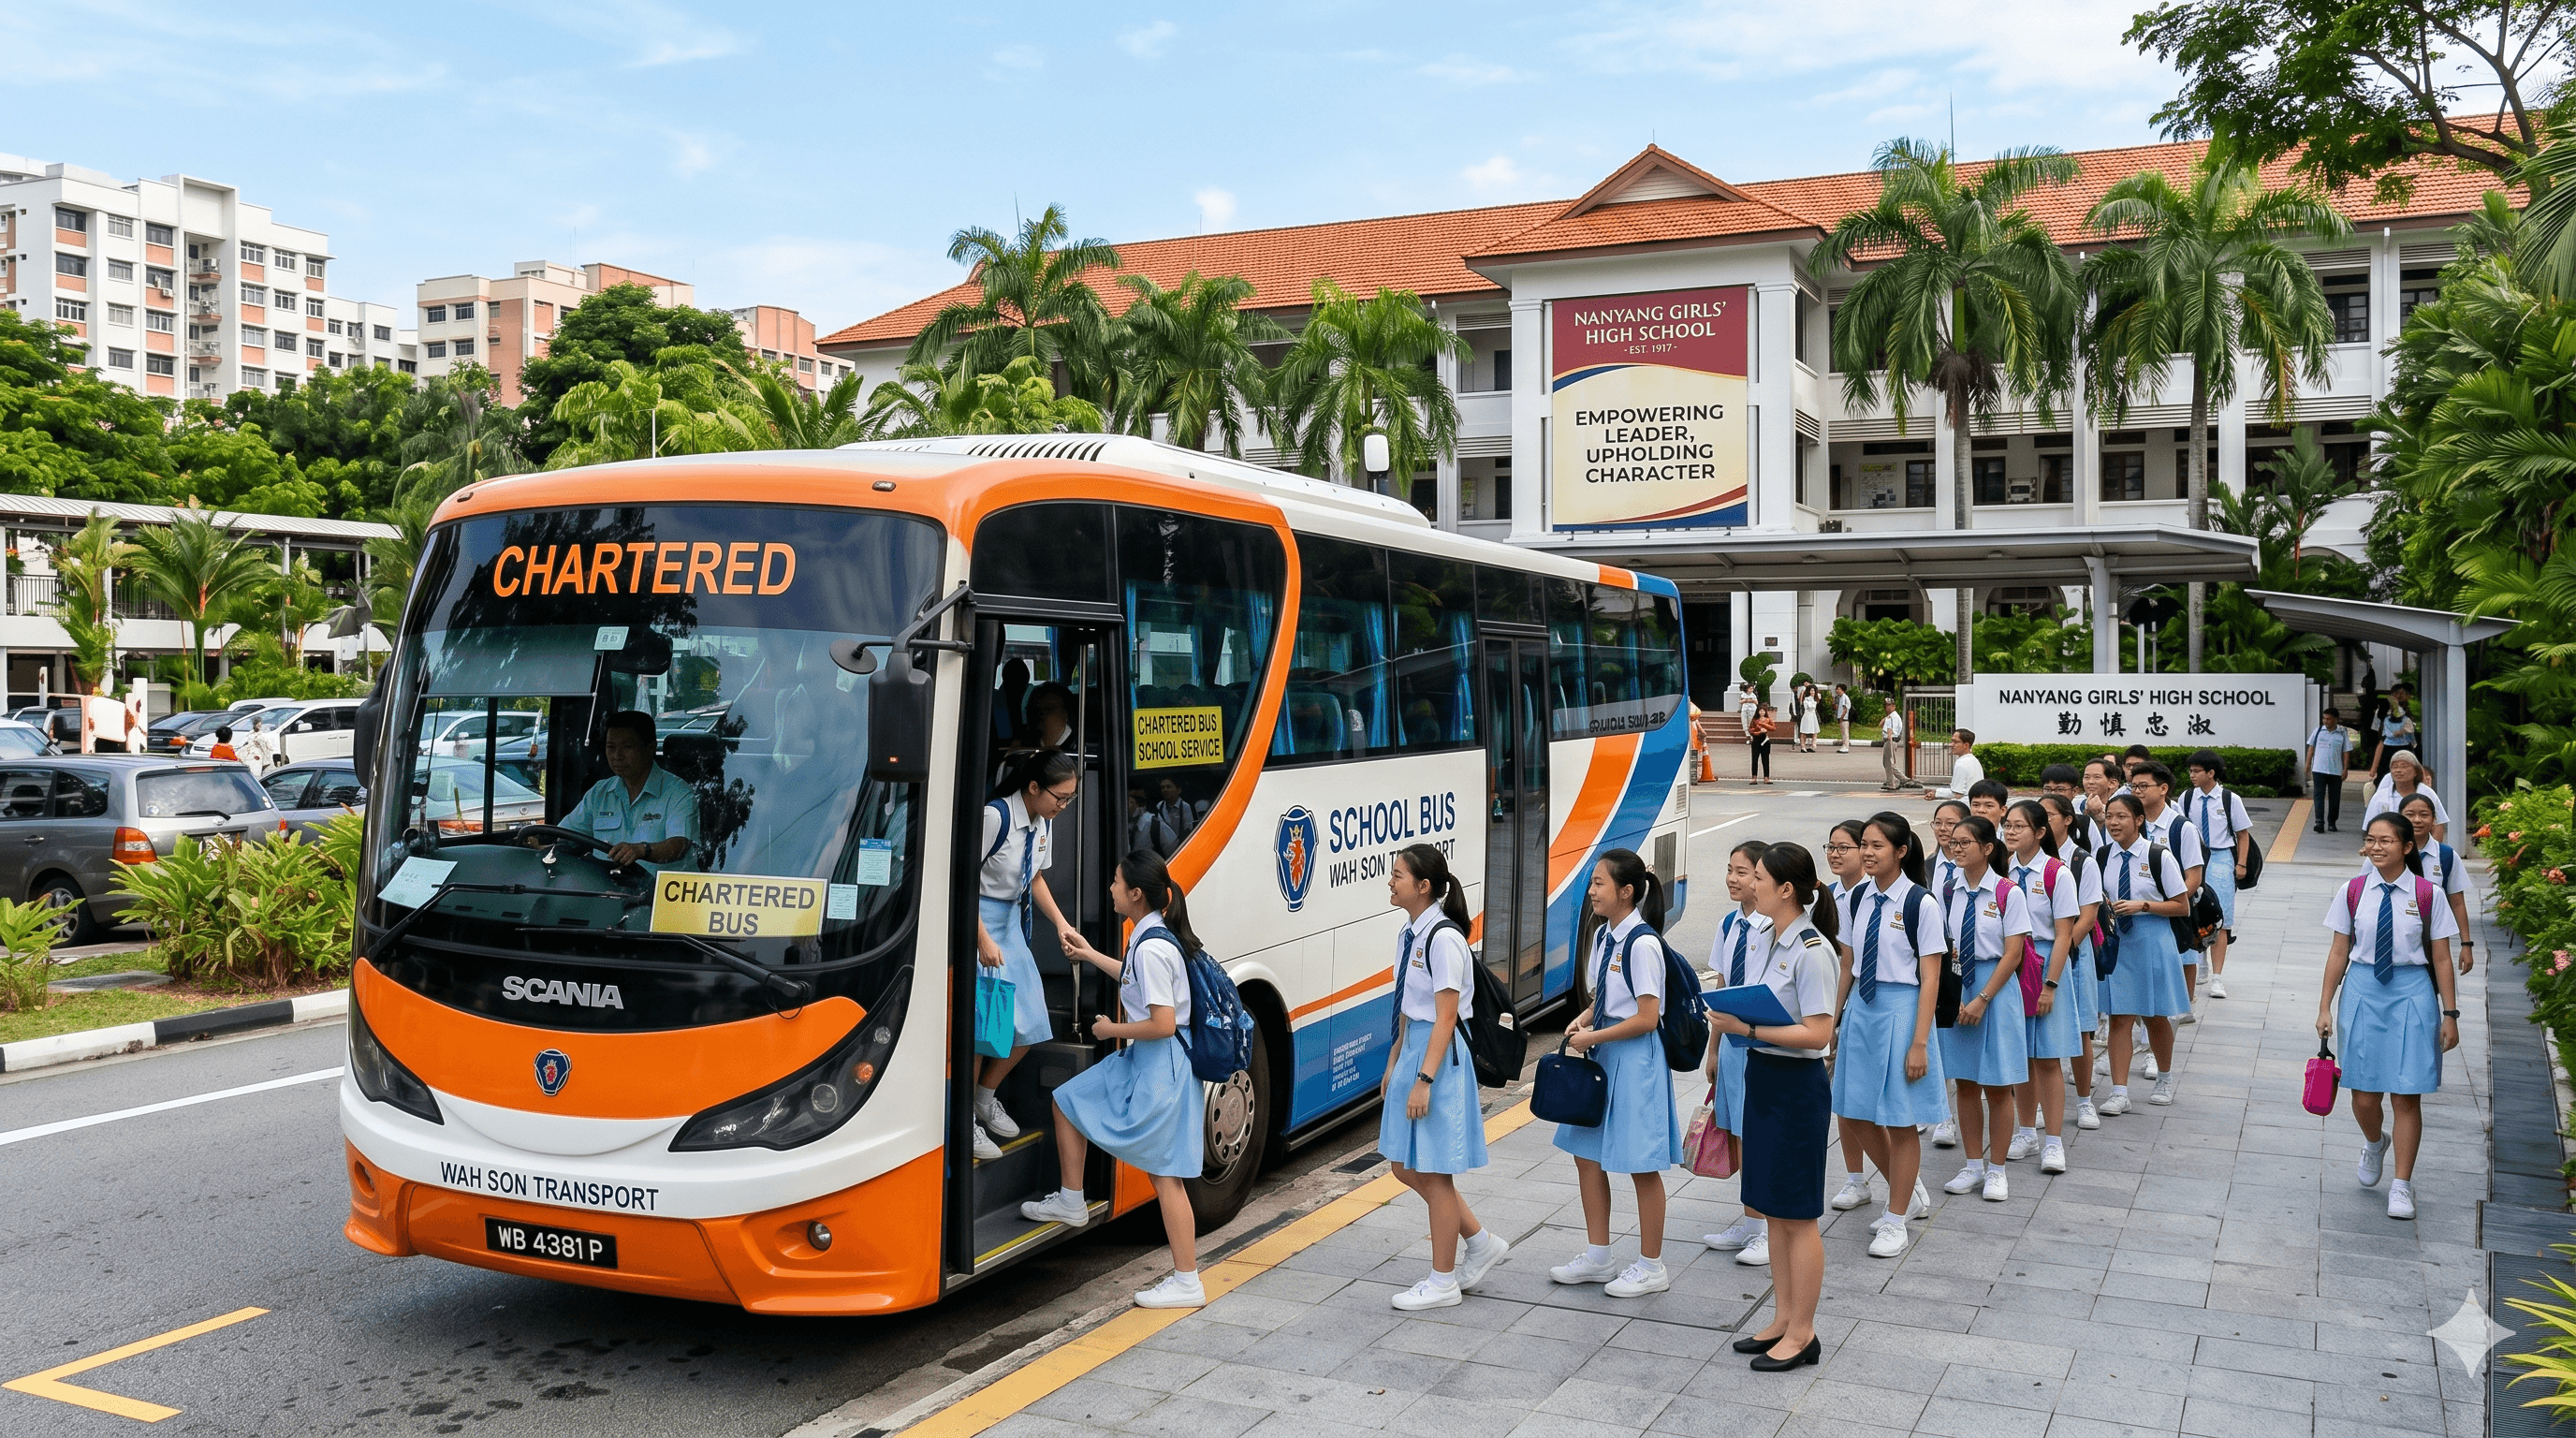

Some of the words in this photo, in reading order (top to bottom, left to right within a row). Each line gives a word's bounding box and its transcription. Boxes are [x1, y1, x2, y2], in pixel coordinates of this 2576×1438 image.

[1574, 306, 1663, 327] NANYANG
[1586, 327, 1632, 345] HIGH
[1639, 321, 1717, 341] SCHOOL
[1575, 404, 1724, 426] EMPOWERING
[1605, 426, 1695, 443] LEADER,
[1587, 444, 1714, 463] UPHOLDING
[1586, 463, 1715, 483] CHARACTER
[493, 542, 796, 597] CHARTERED
[1999, 690, 2083, 704] NANYANG
[2087, 690, 2144, 704] GIRLS'
[2150, 690, 2192, 705] HIGH
[2199, 690, 2276, 705] SCHOOL
[1138, 714, 1196, 735] CHARTERED
[1198, 713, 1217, 732] BUS
[1138, 741, 1178, 761] SCHOOL
[1180, 739, 1220, 758] SERVICE
[1329, 799, 1414, 854] SCHOOL
[1420, 791, 1456, 835] BUS
[1329, 859, 1357, 888] WAH
[1361, 853, 1385, 881] SON
[664, 881, 816, 910] CHARTERED
[708, 911, 759, 936] BUS
[502, 976, 624, 1010] SCANIA
[440, 1161, 482, 1189] WAH
[487, 1169, 527, 1196] SON
[533, 1176, 659, 1211] TRANSPORT
[498, 1225, 526, 1251] WB
[533, 1232, 583, 1259] 4381
[589, 1240, 603, 1261] P
